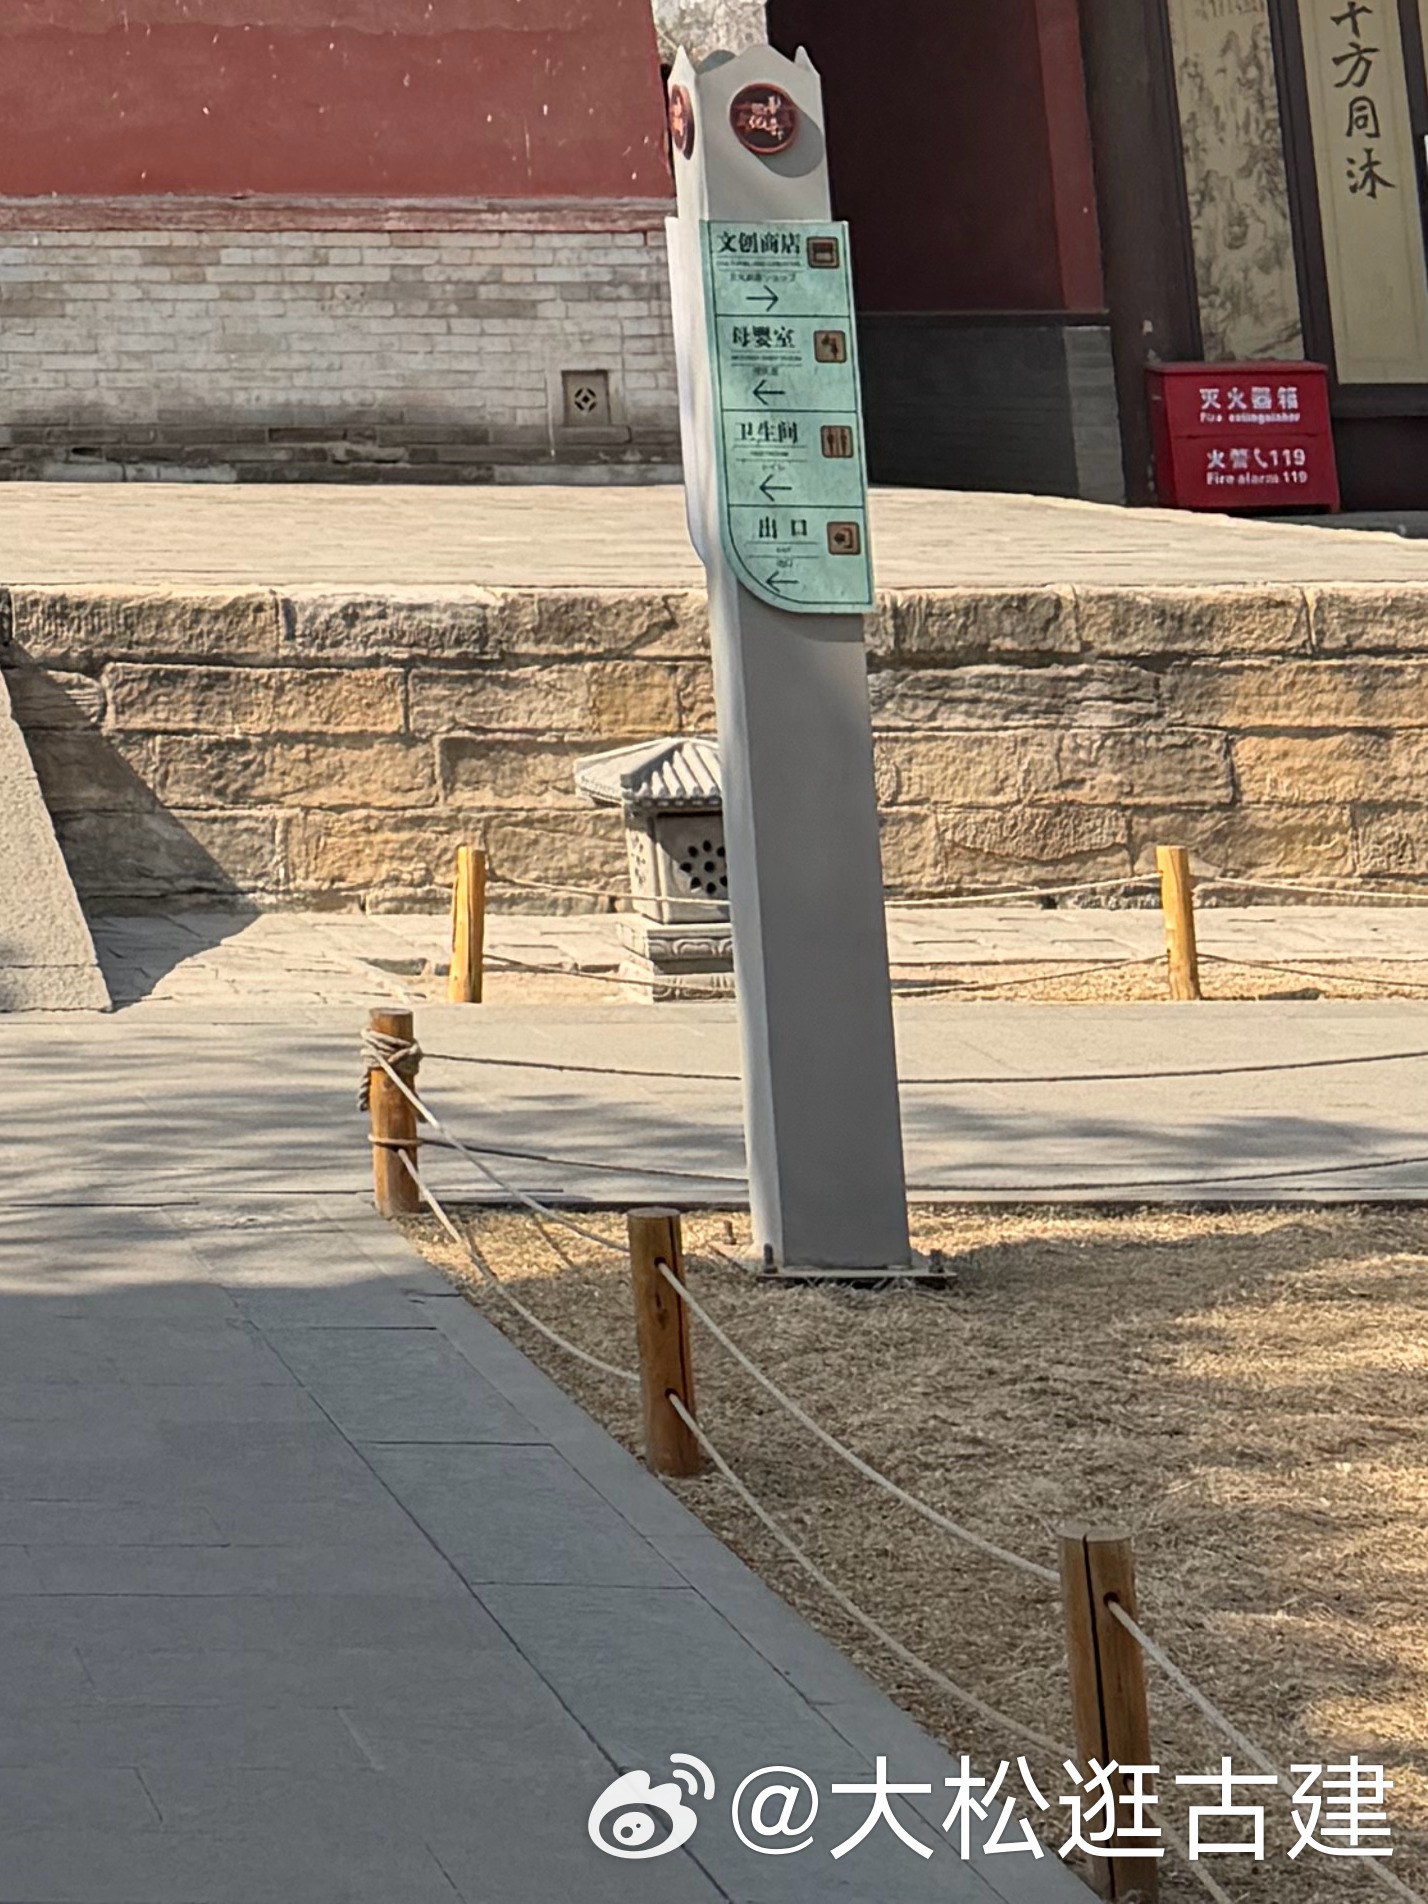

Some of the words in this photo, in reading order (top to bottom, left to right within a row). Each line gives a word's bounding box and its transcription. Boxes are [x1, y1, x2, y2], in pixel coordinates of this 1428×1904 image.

[1330, 0, 1396, 200] 十方同沐
[716, 230, 801, 255] 文创商店
[732, 325, 796, 349] 母婴室
[1199, 385, 1299, 411] 灭火器箱
[734, 420, 798, 445] 卫生间
[1269, 448, 1306, 467] 119
[1206, 472, 1235, 486] Fire
[1238, 471, 1279, 485] alarm
[1283, 470, 1308, 484] 119
[757, 515, 808, 540] 出口
